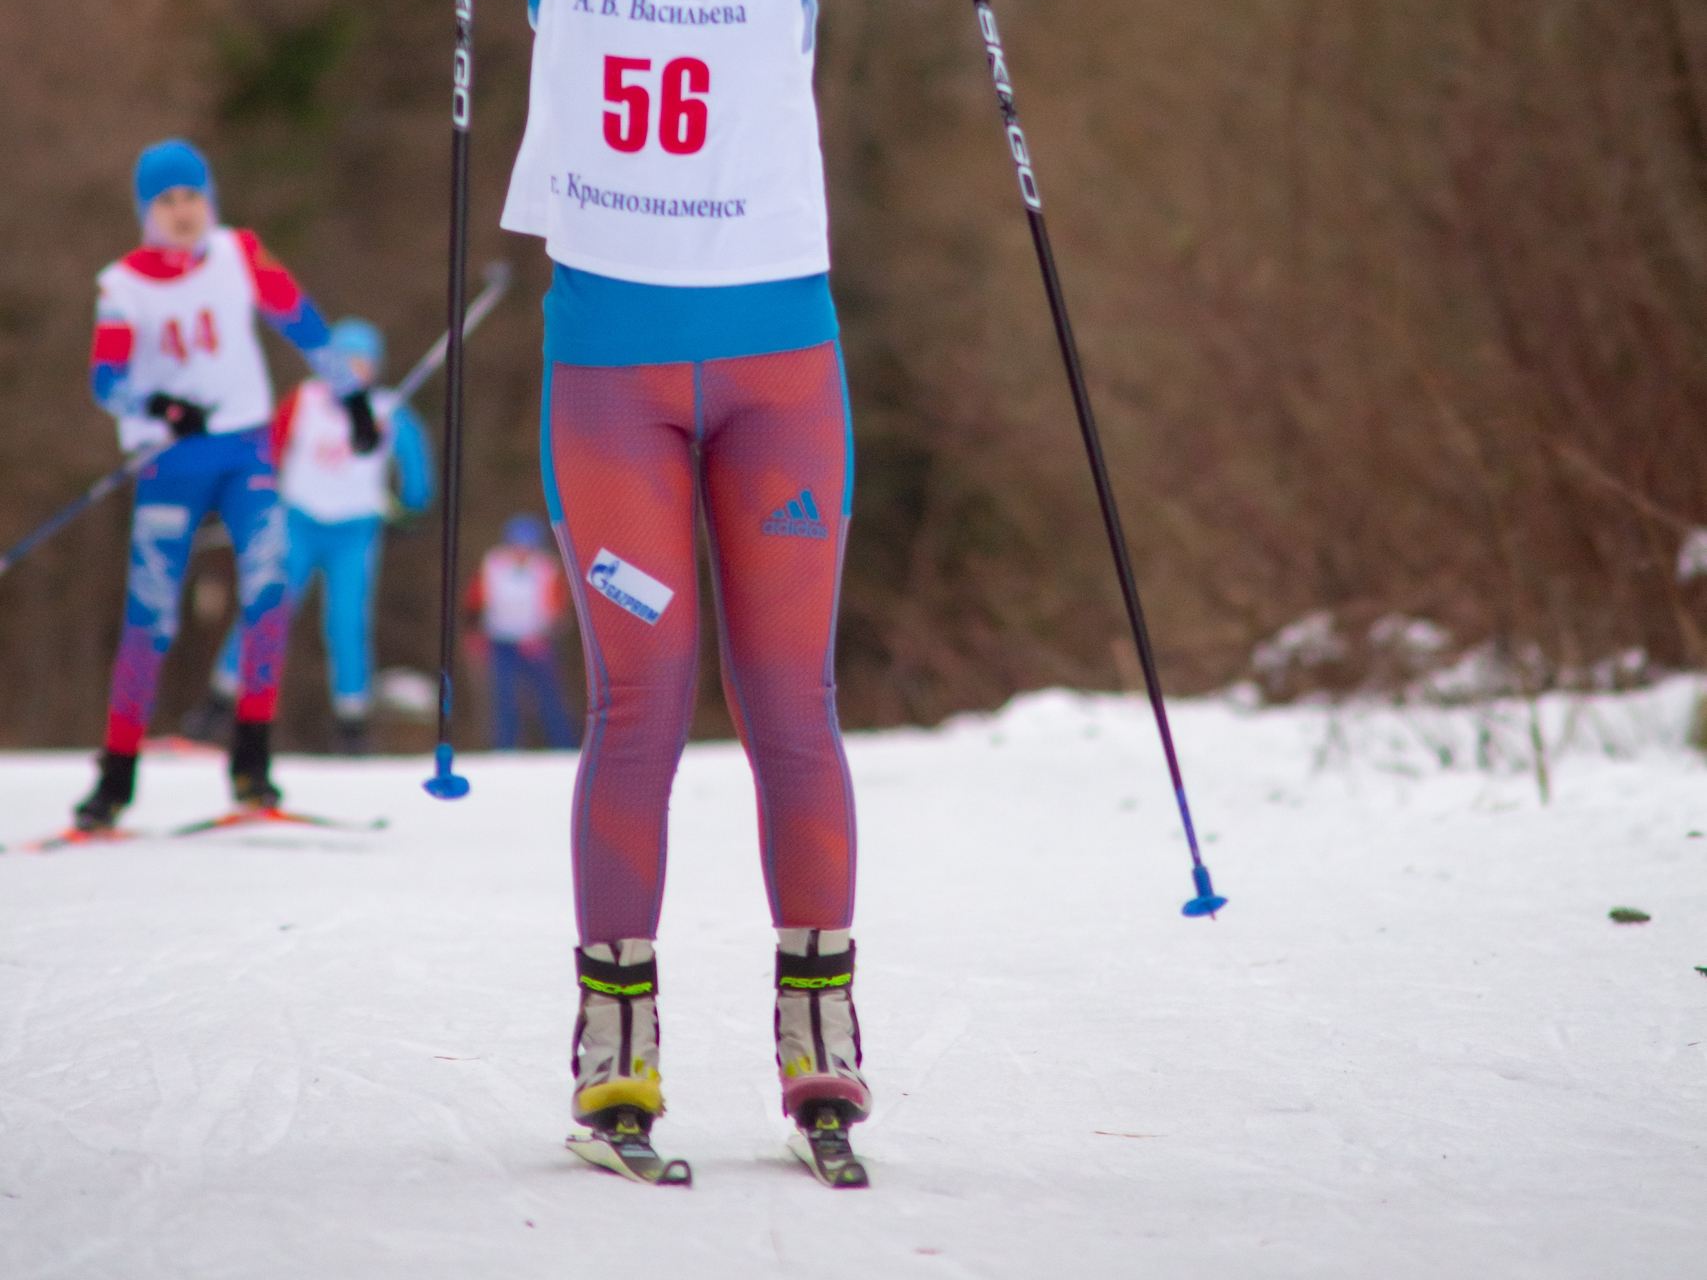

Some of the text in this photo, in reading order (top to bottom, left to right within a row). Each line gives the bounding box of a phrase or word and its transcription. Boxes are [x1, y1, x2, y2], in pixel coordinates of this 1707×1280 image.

[603, 53, 711, 155] 56
[566, 172, 748, 218] Краснознаменск
[159, 309, 220, 365] 44
[761, 519, 829, 540] adidas
